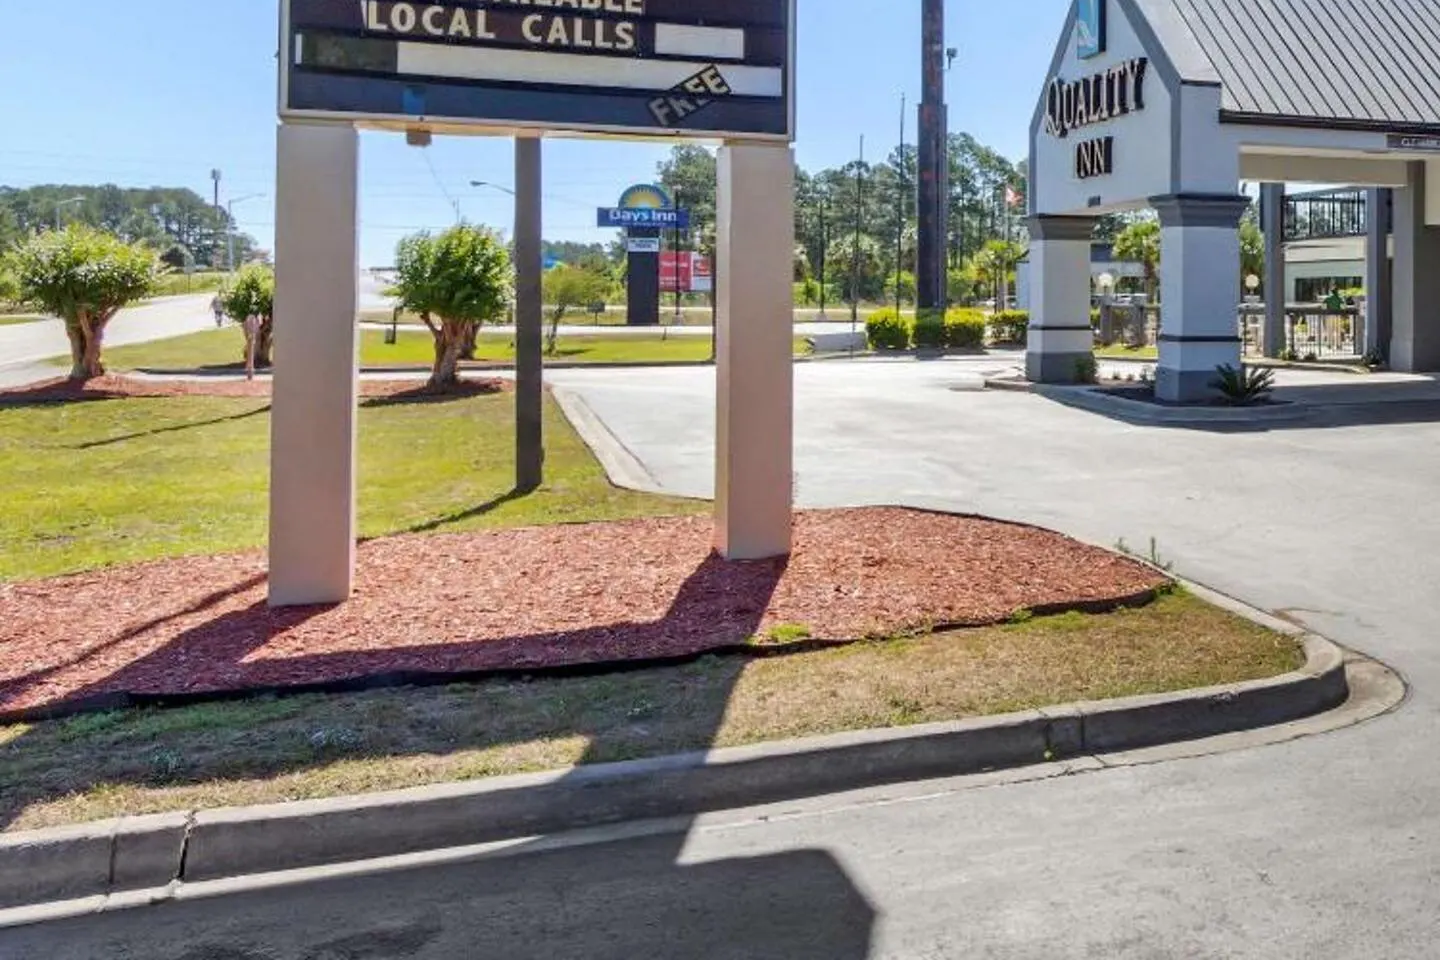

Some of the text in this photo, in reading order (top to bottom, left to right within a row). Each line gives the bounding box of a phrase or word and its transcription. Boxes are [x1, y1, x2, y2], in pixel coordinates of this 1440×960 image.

[367, 0, 635, 50] LOCAL CALLS
[647, 64, 731, 126] FREE
[1045, 57, 1148, 139] QUALITY
[1075, 136, 1114, 179] INN
[608, 209, 677, 222] Days Inn
